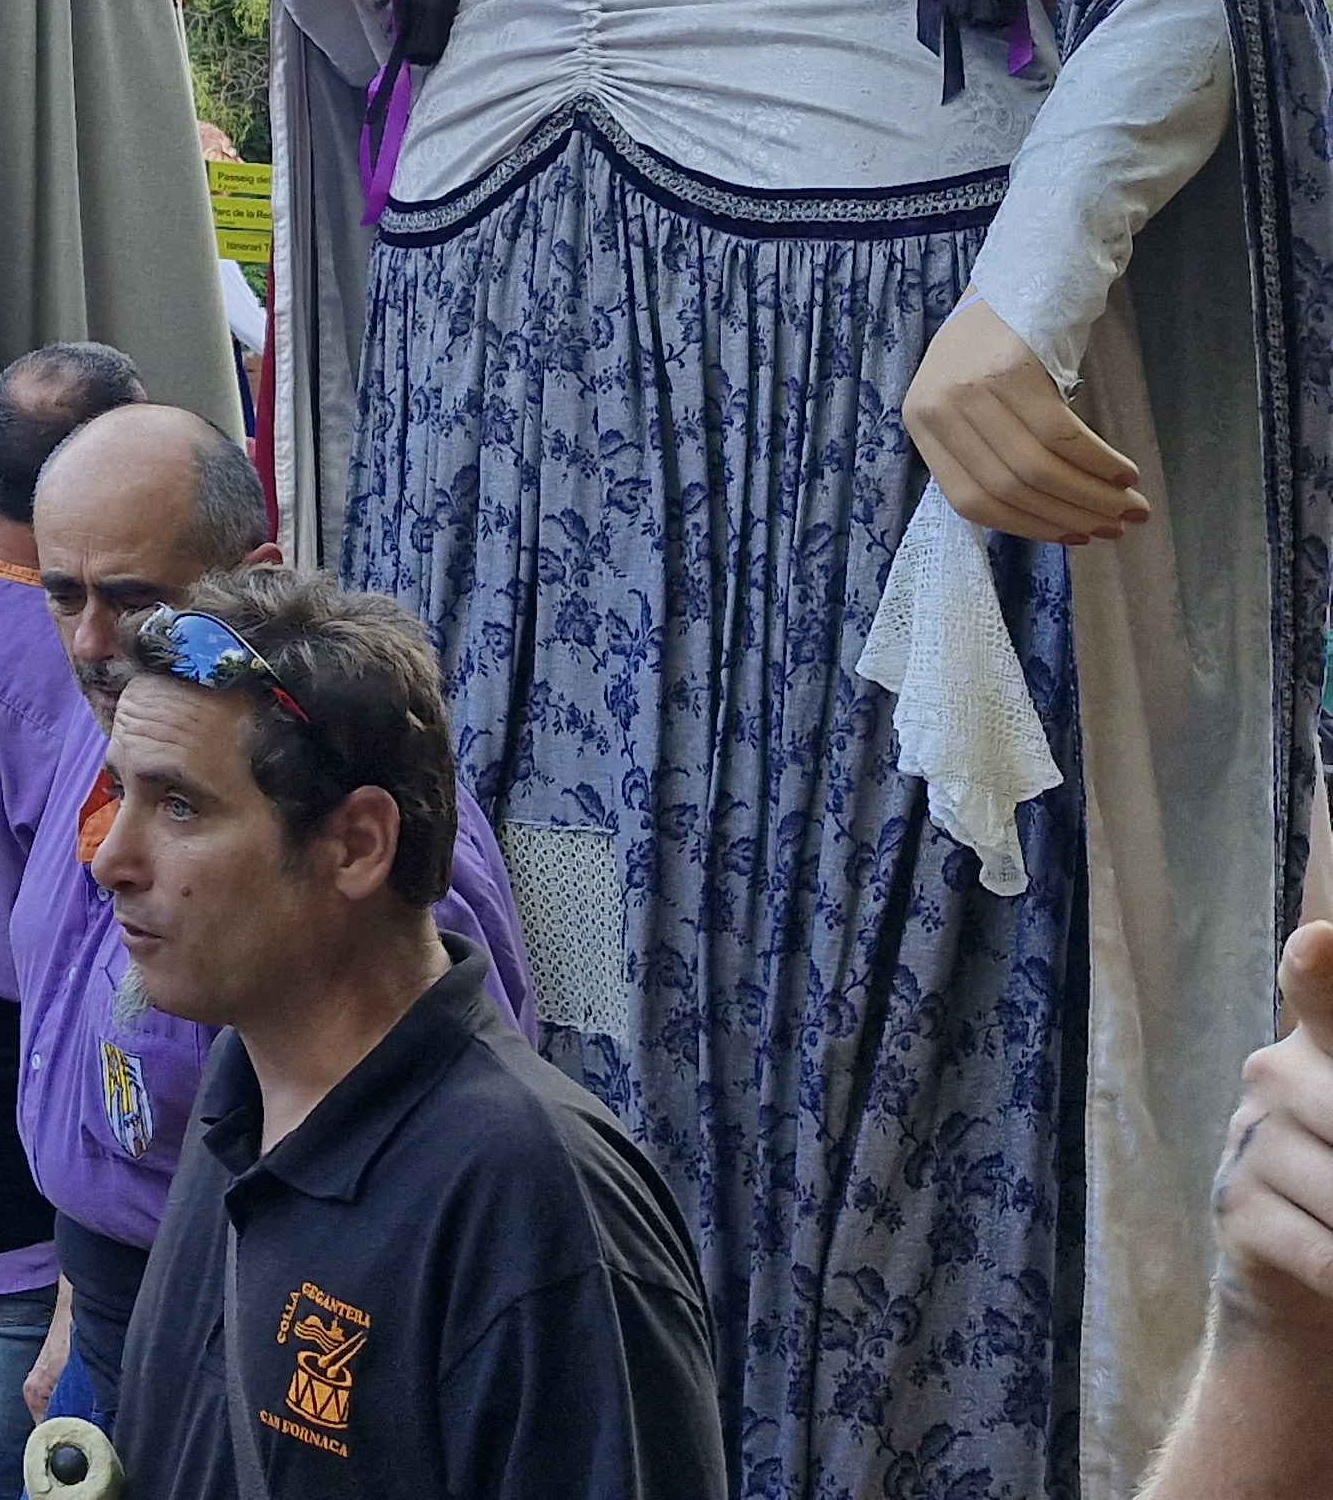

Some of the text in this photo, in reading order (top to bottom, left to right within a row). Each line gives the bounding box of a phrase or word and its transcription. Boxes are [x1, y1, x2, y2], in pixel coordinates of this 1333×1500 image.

[217, 171, 254, 185] Passeig
[233, 209, 244, 218] de
[246, 209, 255, 218] la
[226, 241, 262, 252] Itinerari
[276, 1282, 371, 1344] COLLA GEGANTERA
[281, 1419, 349, 1458] FORNACA
